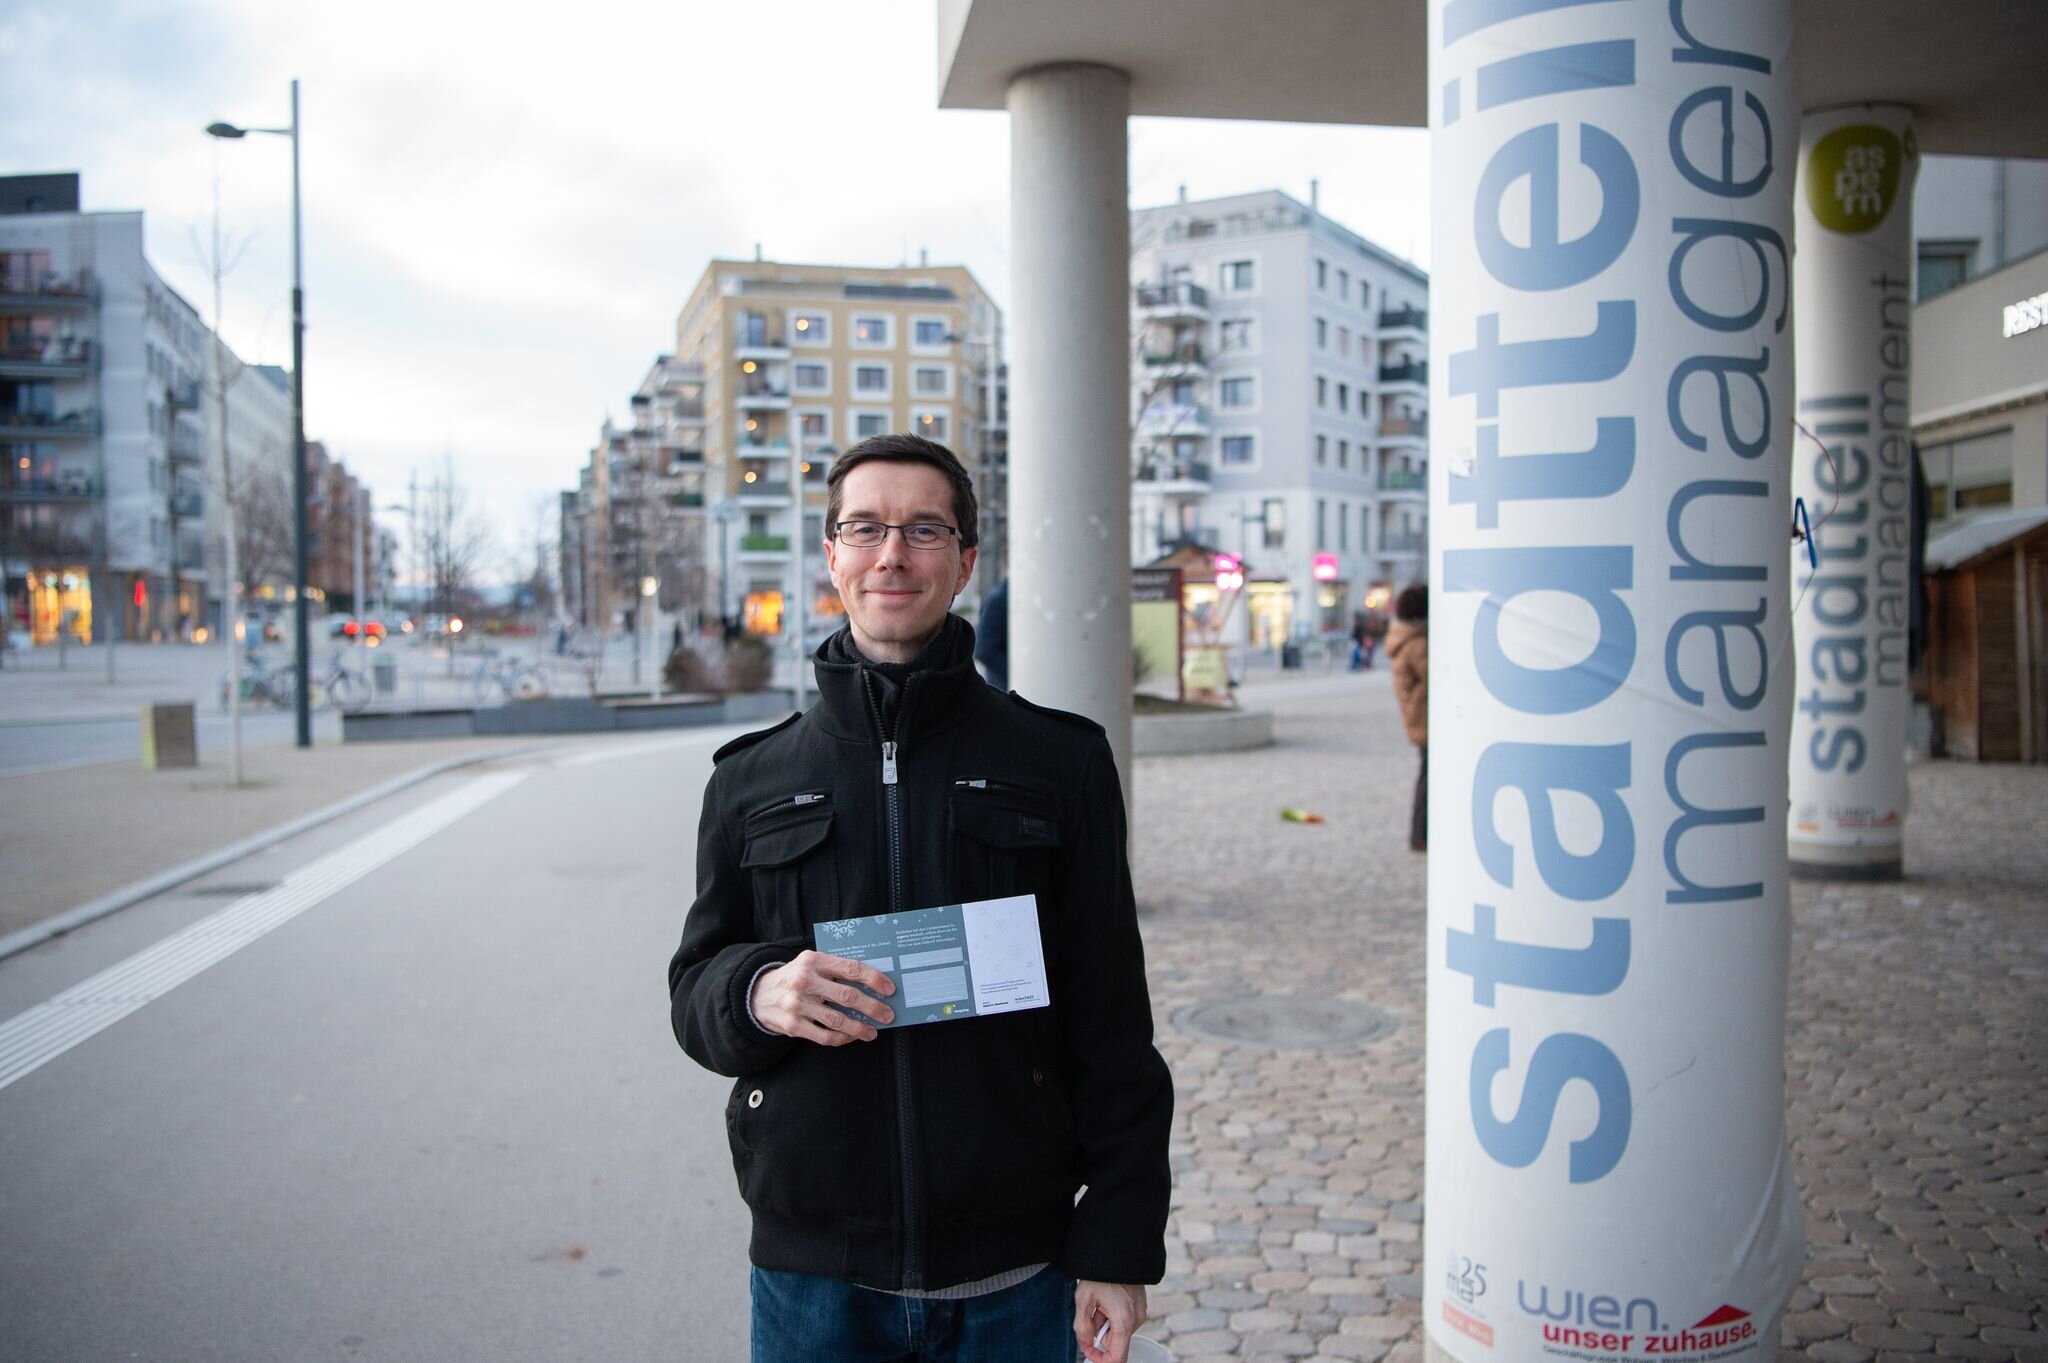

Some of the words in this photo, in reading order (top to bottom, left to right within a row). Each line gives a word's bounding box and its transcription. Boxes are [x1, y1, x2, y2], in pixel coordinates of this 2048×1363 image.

[1797, 394, 1871, 778] stadtteil
[1517, 1279, 1669, 1331] wien.
[1543, 1323, 1634, 1352] unser
[1645, 1321, 1757, 1354] zuhause.
